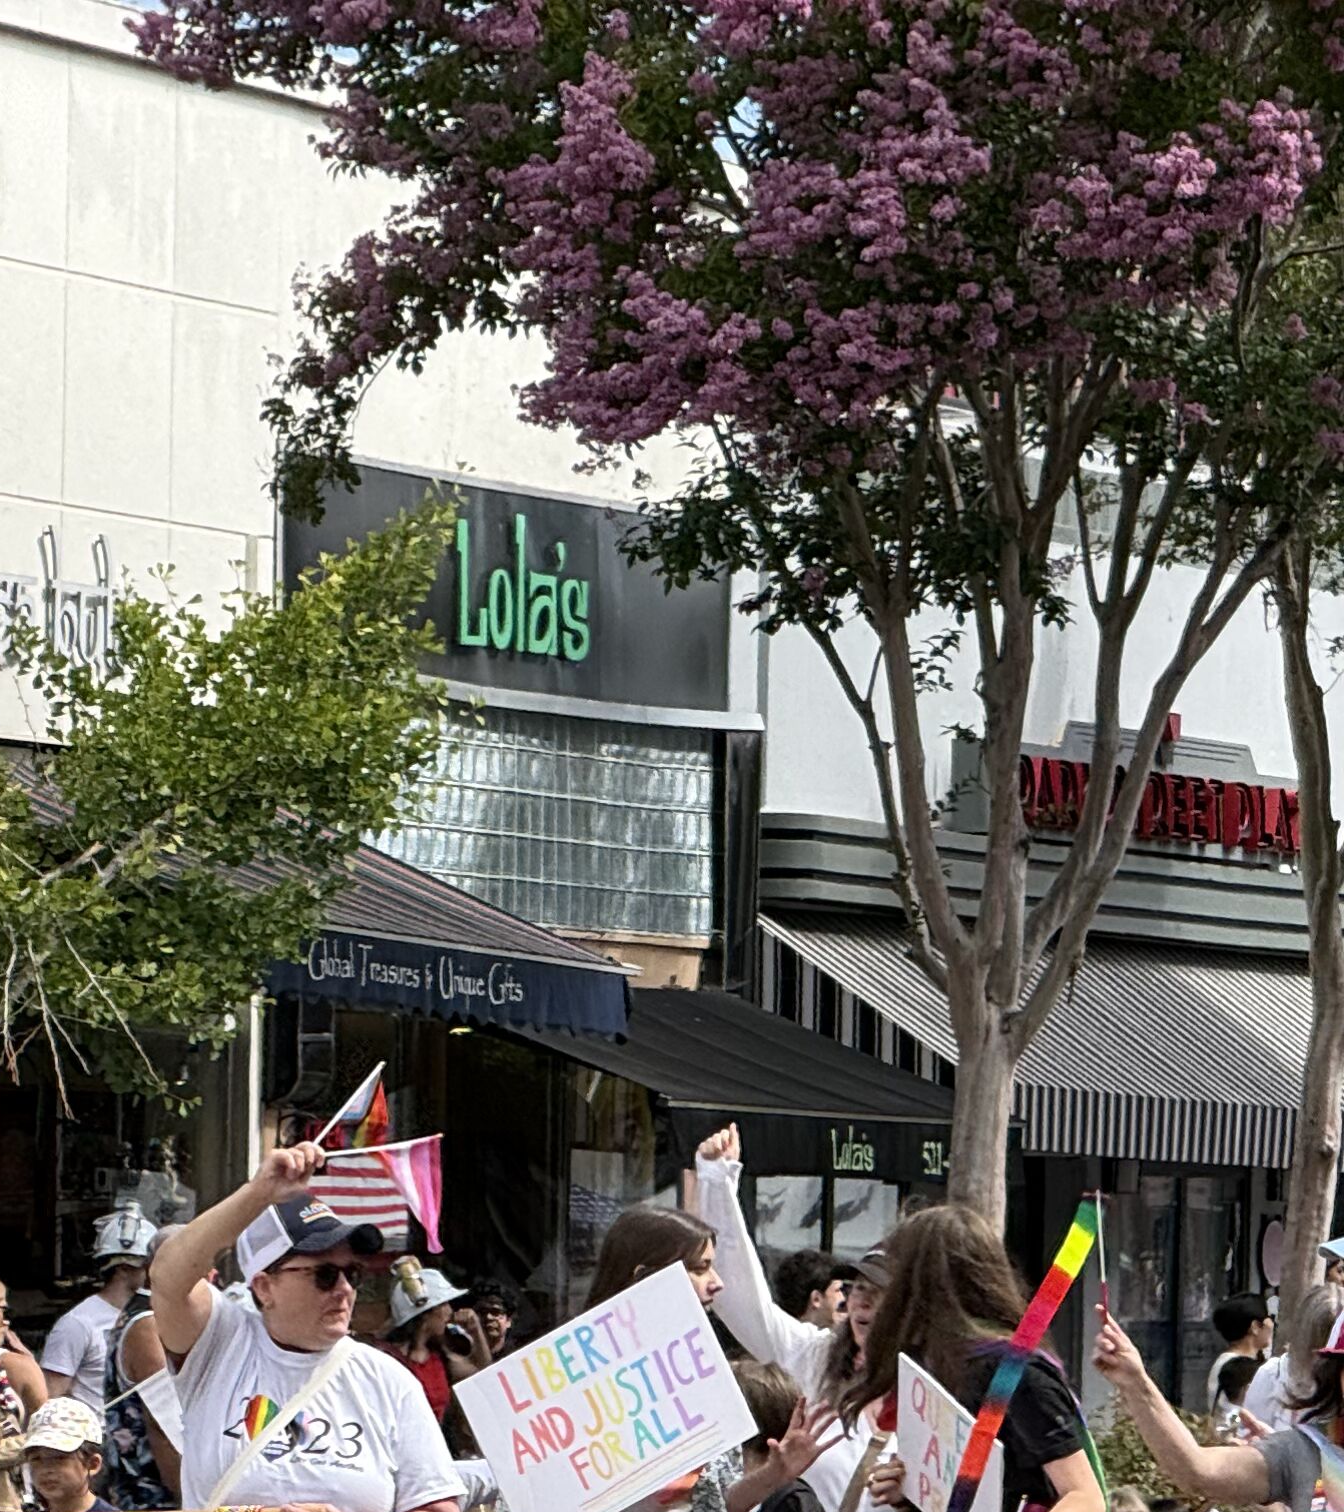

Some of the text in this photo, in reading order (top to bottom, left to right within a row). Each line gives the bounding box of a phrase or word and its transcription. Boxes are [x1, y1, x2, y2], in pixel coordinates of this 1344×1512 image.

[457, 513, 590, 661] Lola's
[1220, 780, 1300, 856] PLA
[308, 937, 355, 981] Global
[358, 943, 421, 987] Treasures
[439, 956, 486, 1010] Unique
[488, 961, 525, 1005] Gifts
[831, 1125, 874, 1172] Lola's
[498, 1299, 643, 1414] LIBERTY
[511, 1327, 716, 1475] AND JUSTICE
[568, 1396, 705, 1490] FOR ALL
[923, 1433, 957, 1490] AN
